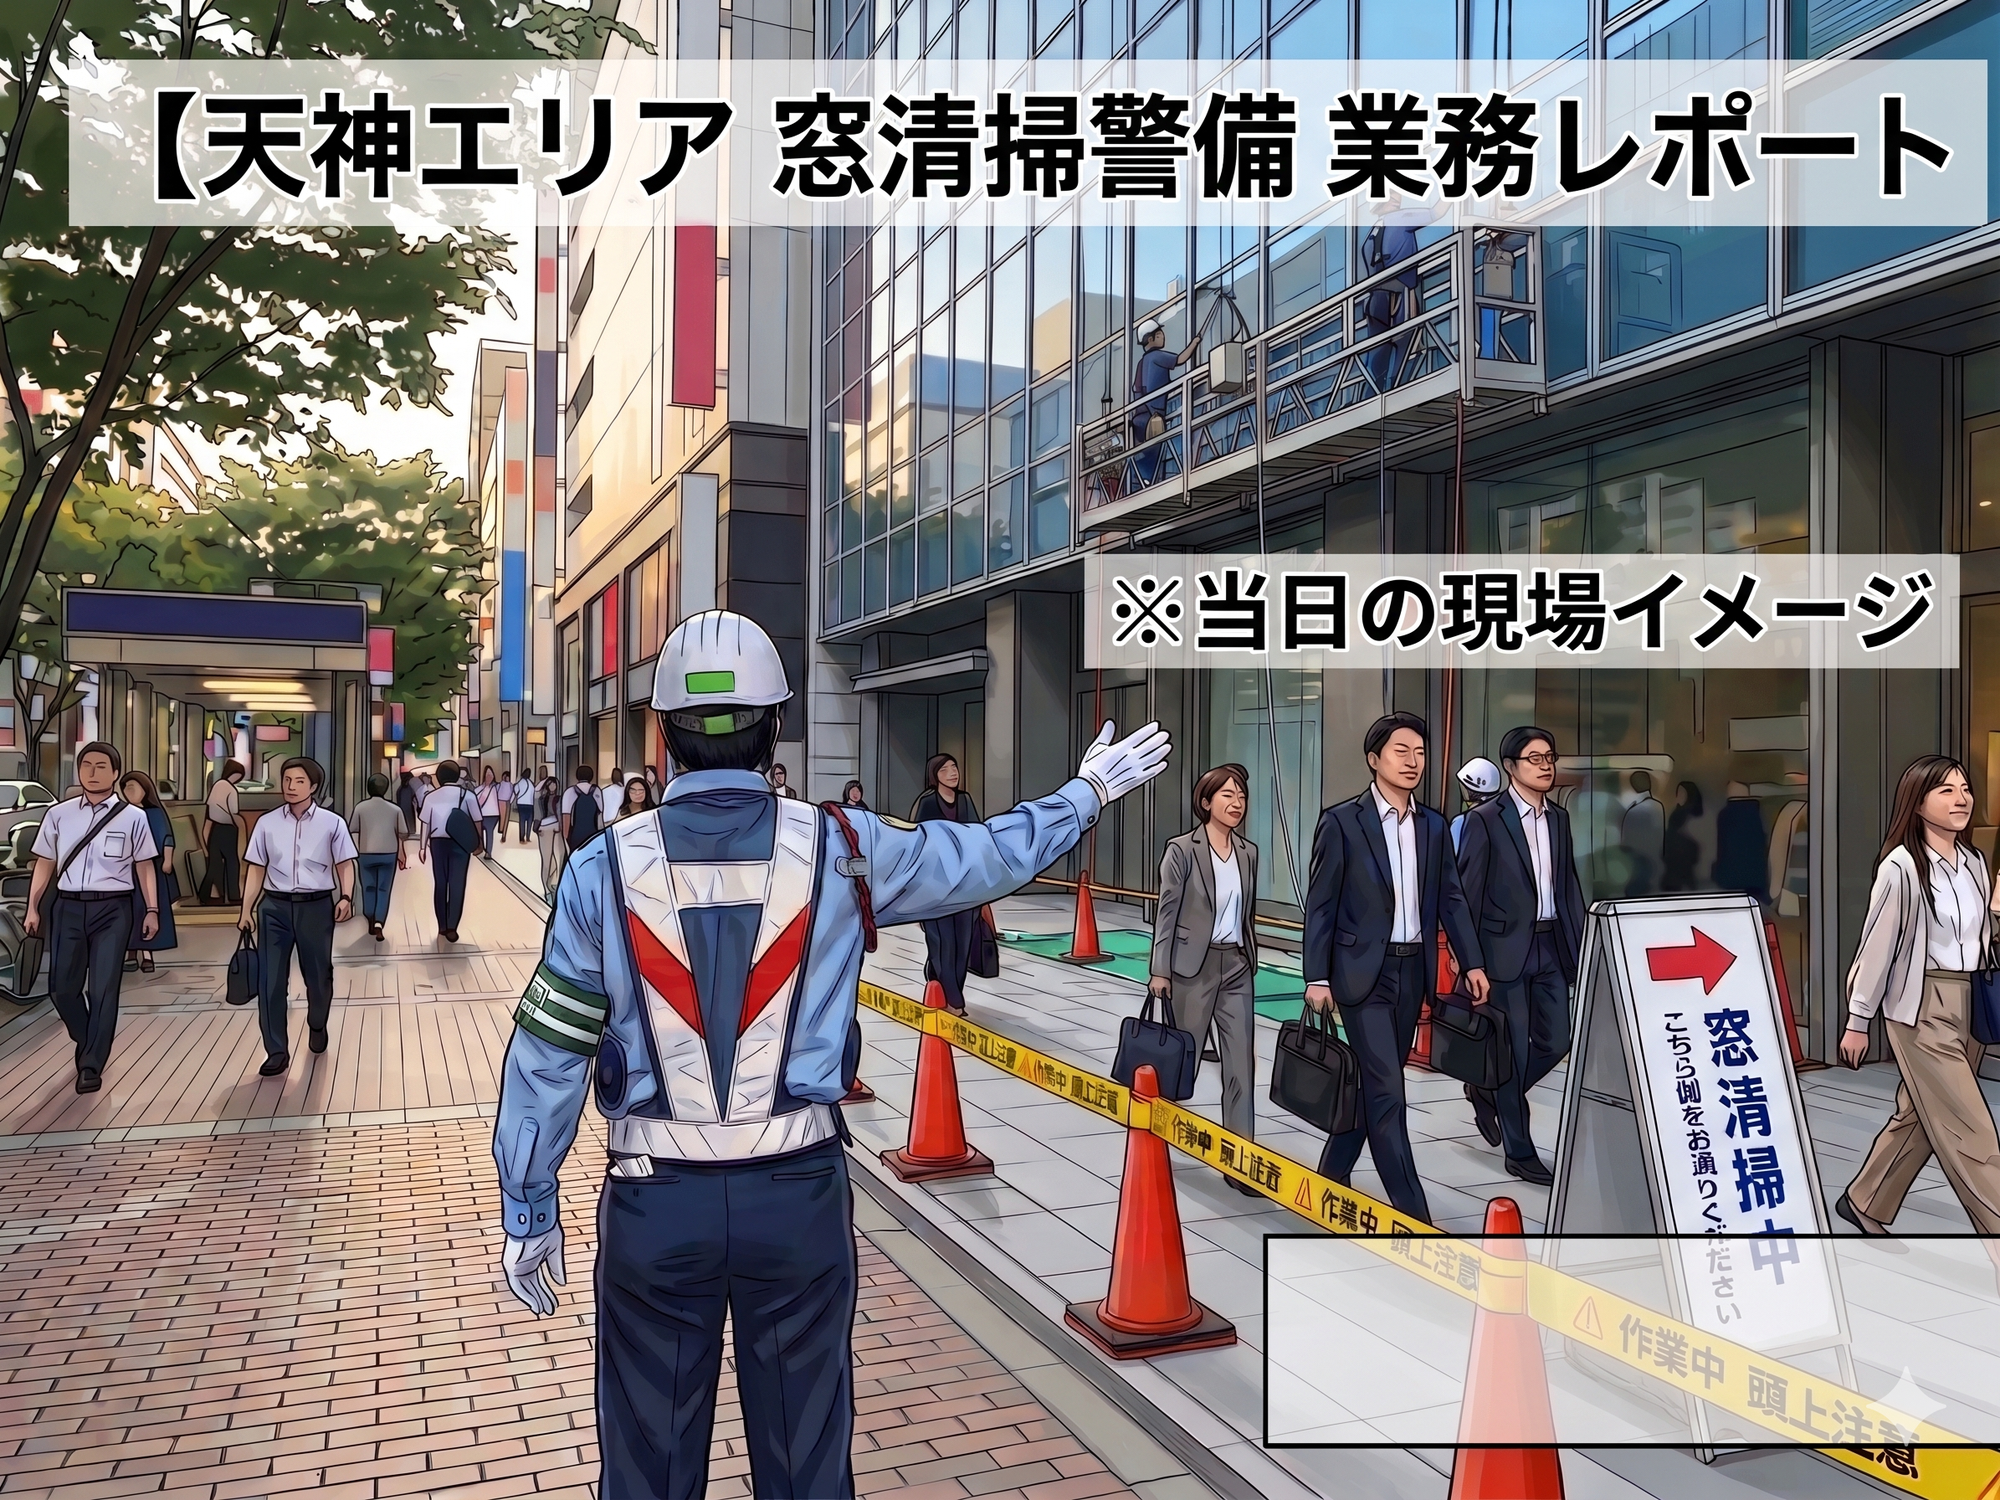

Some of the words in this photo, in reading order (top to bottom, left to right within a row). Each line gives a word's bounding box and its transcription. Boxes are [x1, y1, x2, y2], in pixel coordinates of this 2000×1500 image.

[1703, 1008, 1800, 1285] 窓清掃中
[1618, 1313, 1725, 1390] 作業中
[1747, 1365, 1921, 1480] 頭上注意
